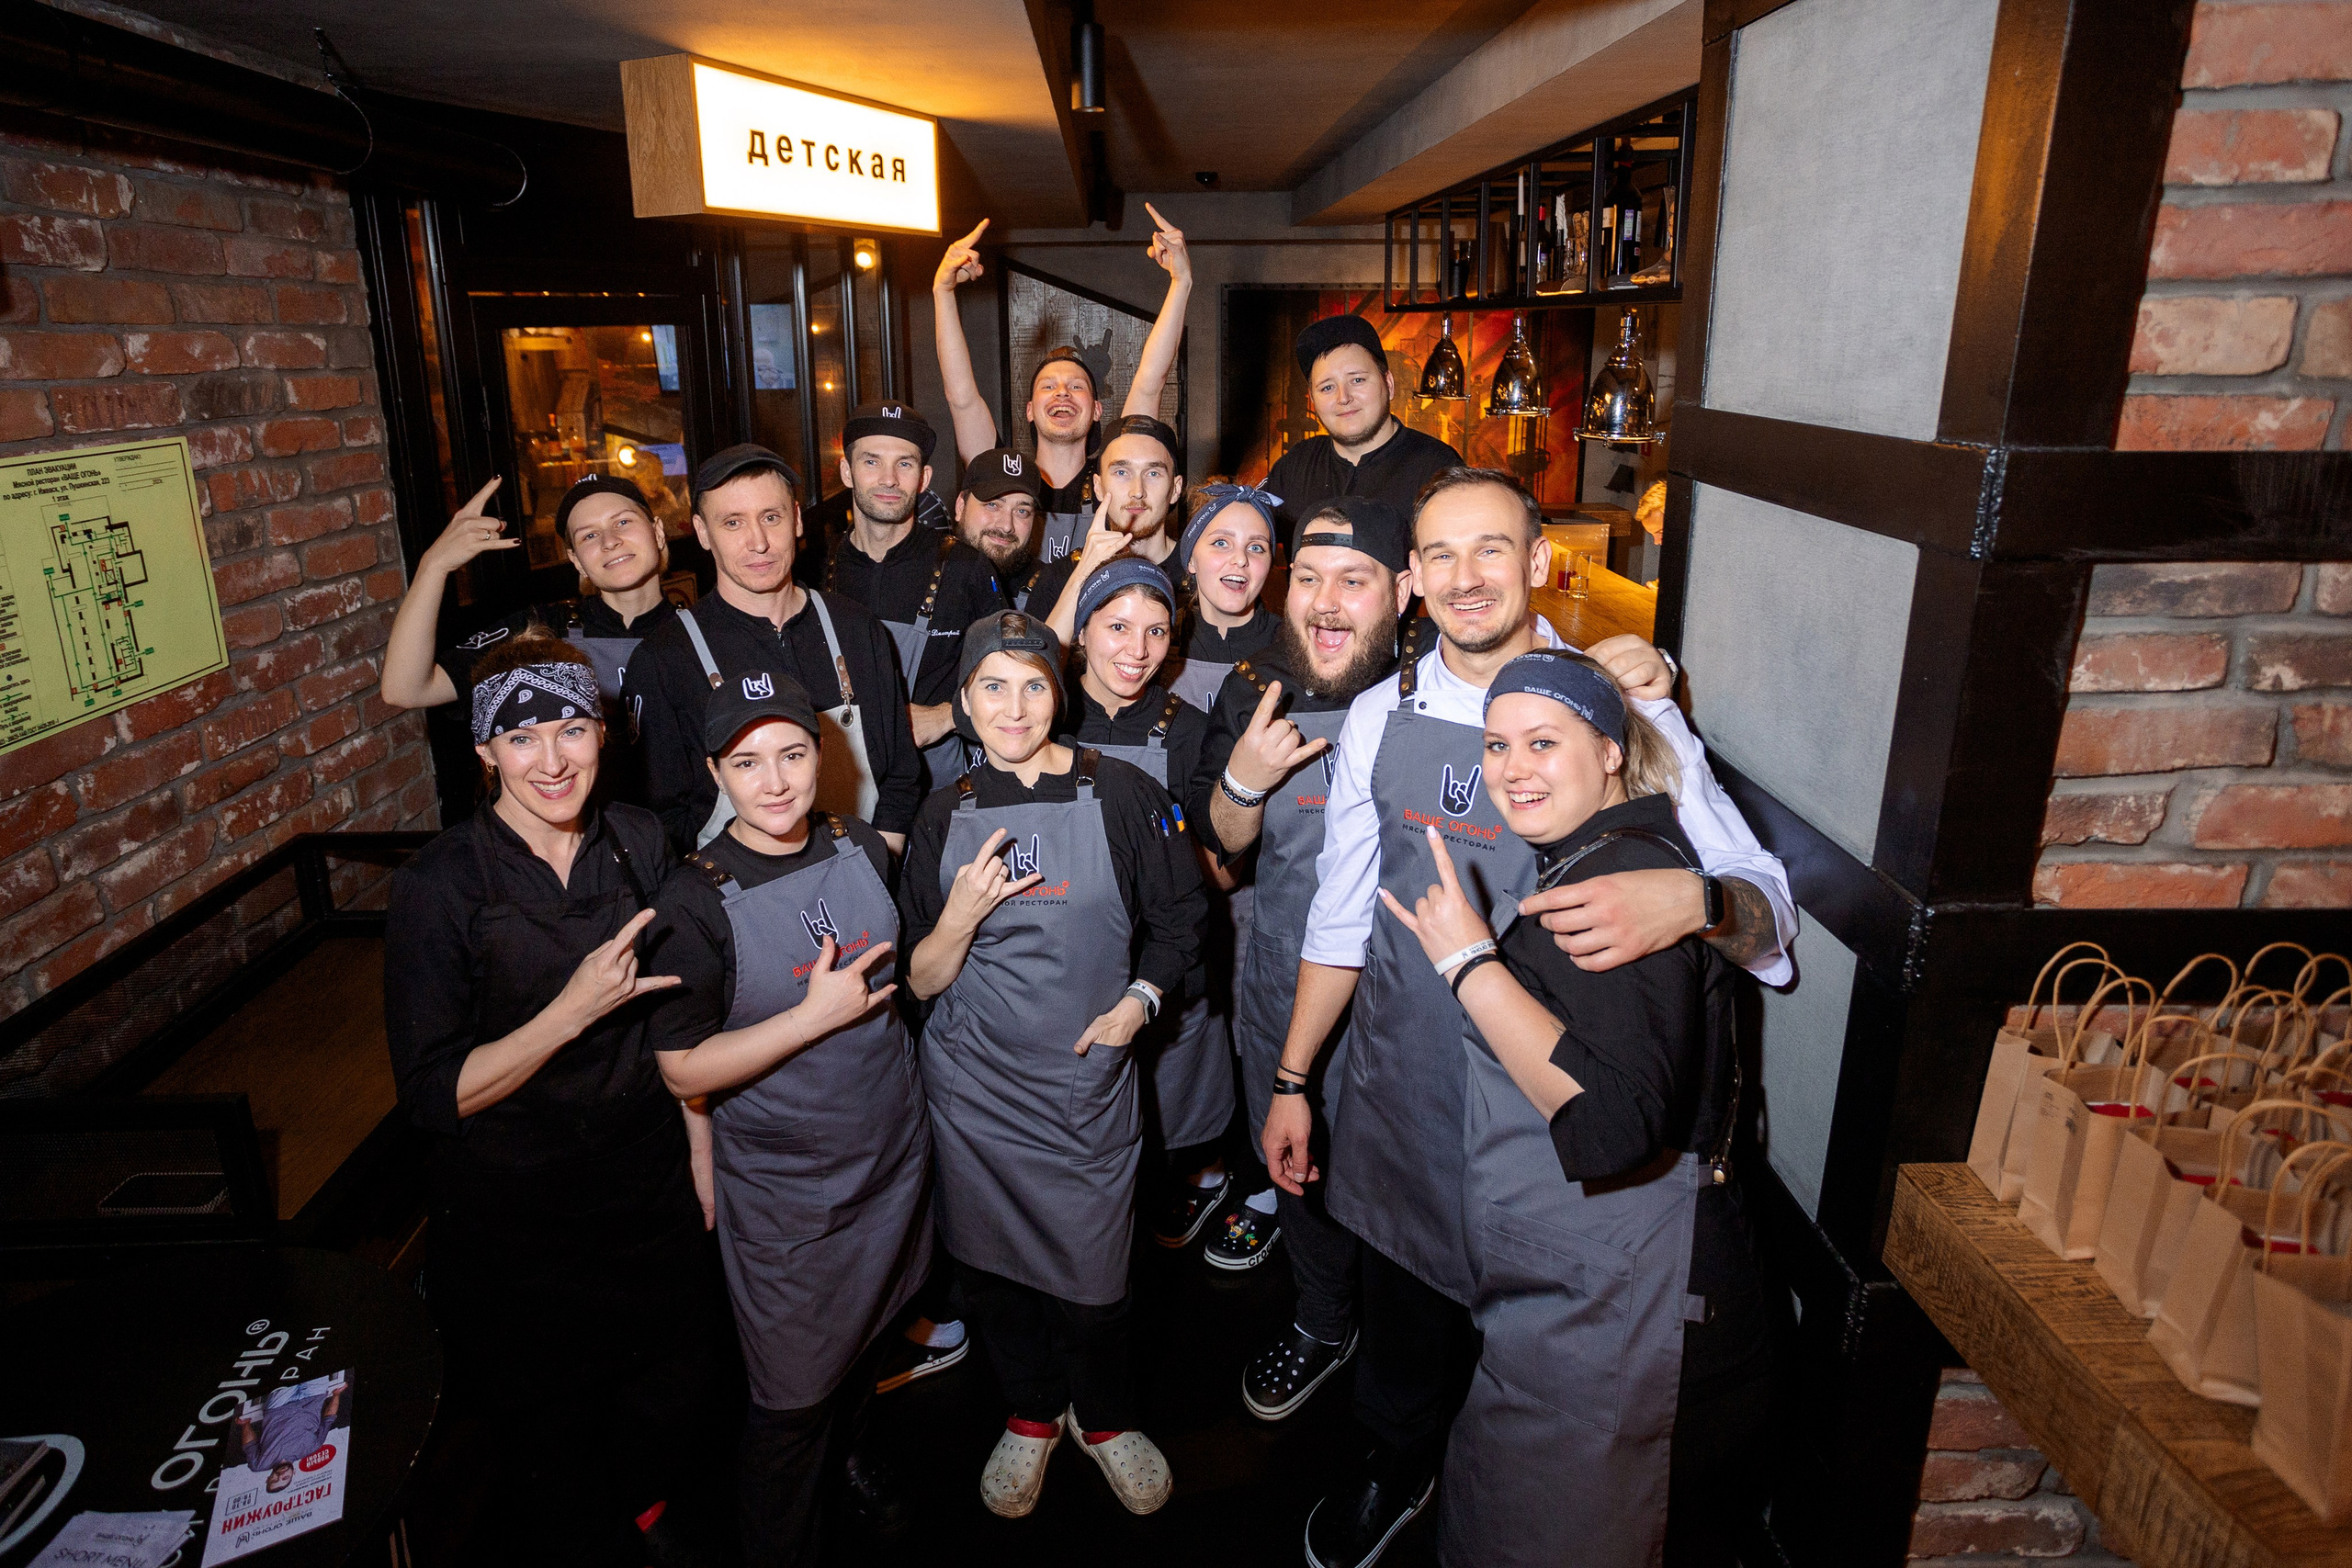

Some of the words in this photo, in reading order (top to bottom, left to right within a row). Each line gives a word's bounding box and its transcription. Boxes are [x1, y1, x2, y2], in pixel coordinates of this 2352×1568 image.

[747, 129, 906, 183] детская
[27, 467, 43, 476] ПЛАН
[44, 463, 77, 473] ЭВАКУАЦИИ
[13, 479, 35, 489] Мясной
[36, 477, 60, 487] ресторан
[101, 477, 110, 485] 223
[1553, 692, 1582, 711] ОГОНЬ
[1297, 795, 1326, 806] ВАШ
[1402, 823, 1426, 836] МЯСН
[1443, 834, 1496, 852] РЕСТОРАН
[306, 1455, 330, 1469] НОВЫЙ
[221, 1482, 332, 1535] ГАСТРОУЖИН
[55, 1548, 105, 1562] SHORT
